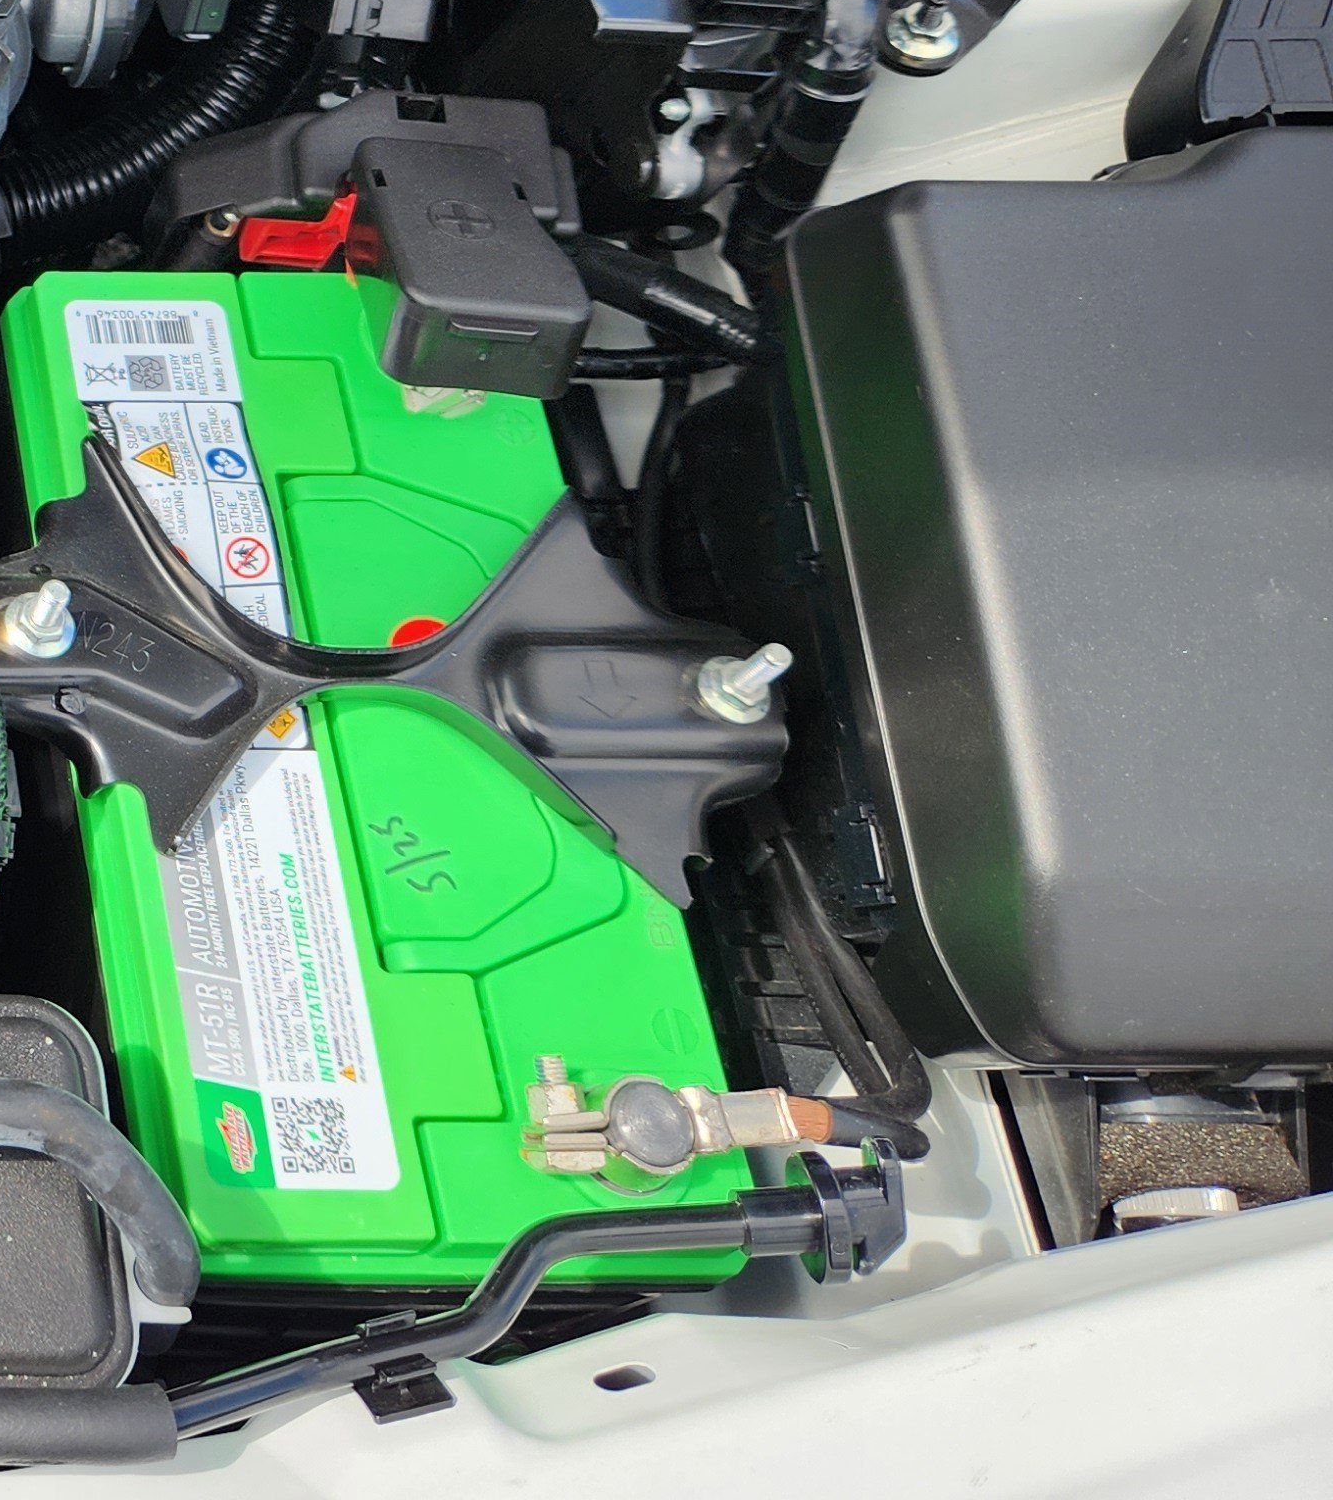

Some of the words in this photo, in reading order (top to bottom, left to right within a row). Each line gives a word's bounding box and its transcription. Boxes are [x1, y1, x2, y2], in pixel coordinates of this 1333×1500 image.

[97, 309, 135, 320] 00346
[205, 318, 220, 355] Vietnam
[169, 353, 185, 391] BATTERY
[180, 354, 192, 366] BE
[211, 357, 222, 366] in
[183, 367, 197, 390] MUST
[215, 371, 228, 393] Made
[199, 422, 212, 443] READ
[212, 490, 225, 508] OUT
[236, 490, 247, 501] OF
[162, 497, 175, 535] FLAMES
[173, 490, 188, 534] SMOKING
[216, 510, 229, 534] KEEP
[227, 502, 239, 520] THE
[239, 503, 254, 532] REACH
[230, 522, 241, 534] OF
[74, 611, 155, 672] N243
[239, 797, 254, 832] Dallas
[192, 820, 213, 885] REPLACEMEN
[244, 838, 261, 869] 14221
[203, 887, 218, 912] FREE
[255, 875, 273, 931] Batteries,
[269, 889, 284, 914] USA
[208, 913, 228, 969] 24-MONTH
[273, 917, 292, 954] 75254
[265, 934, 284, 992] Interstate
[279, 957, 295, 974] TX
[279, 853, 336, 1083] INTERSTATEBATTERIES.COM
[276, 995, 289, 1010] by
[287, 977, 303, 1017] Dallas,
[195, 983, 232, 1075] MT-51R
[294, 1021, 309, 1052] 1000,
[277, 1014, 300, 1082] Distributed
[231, 1052, 246, 1076] CCA
